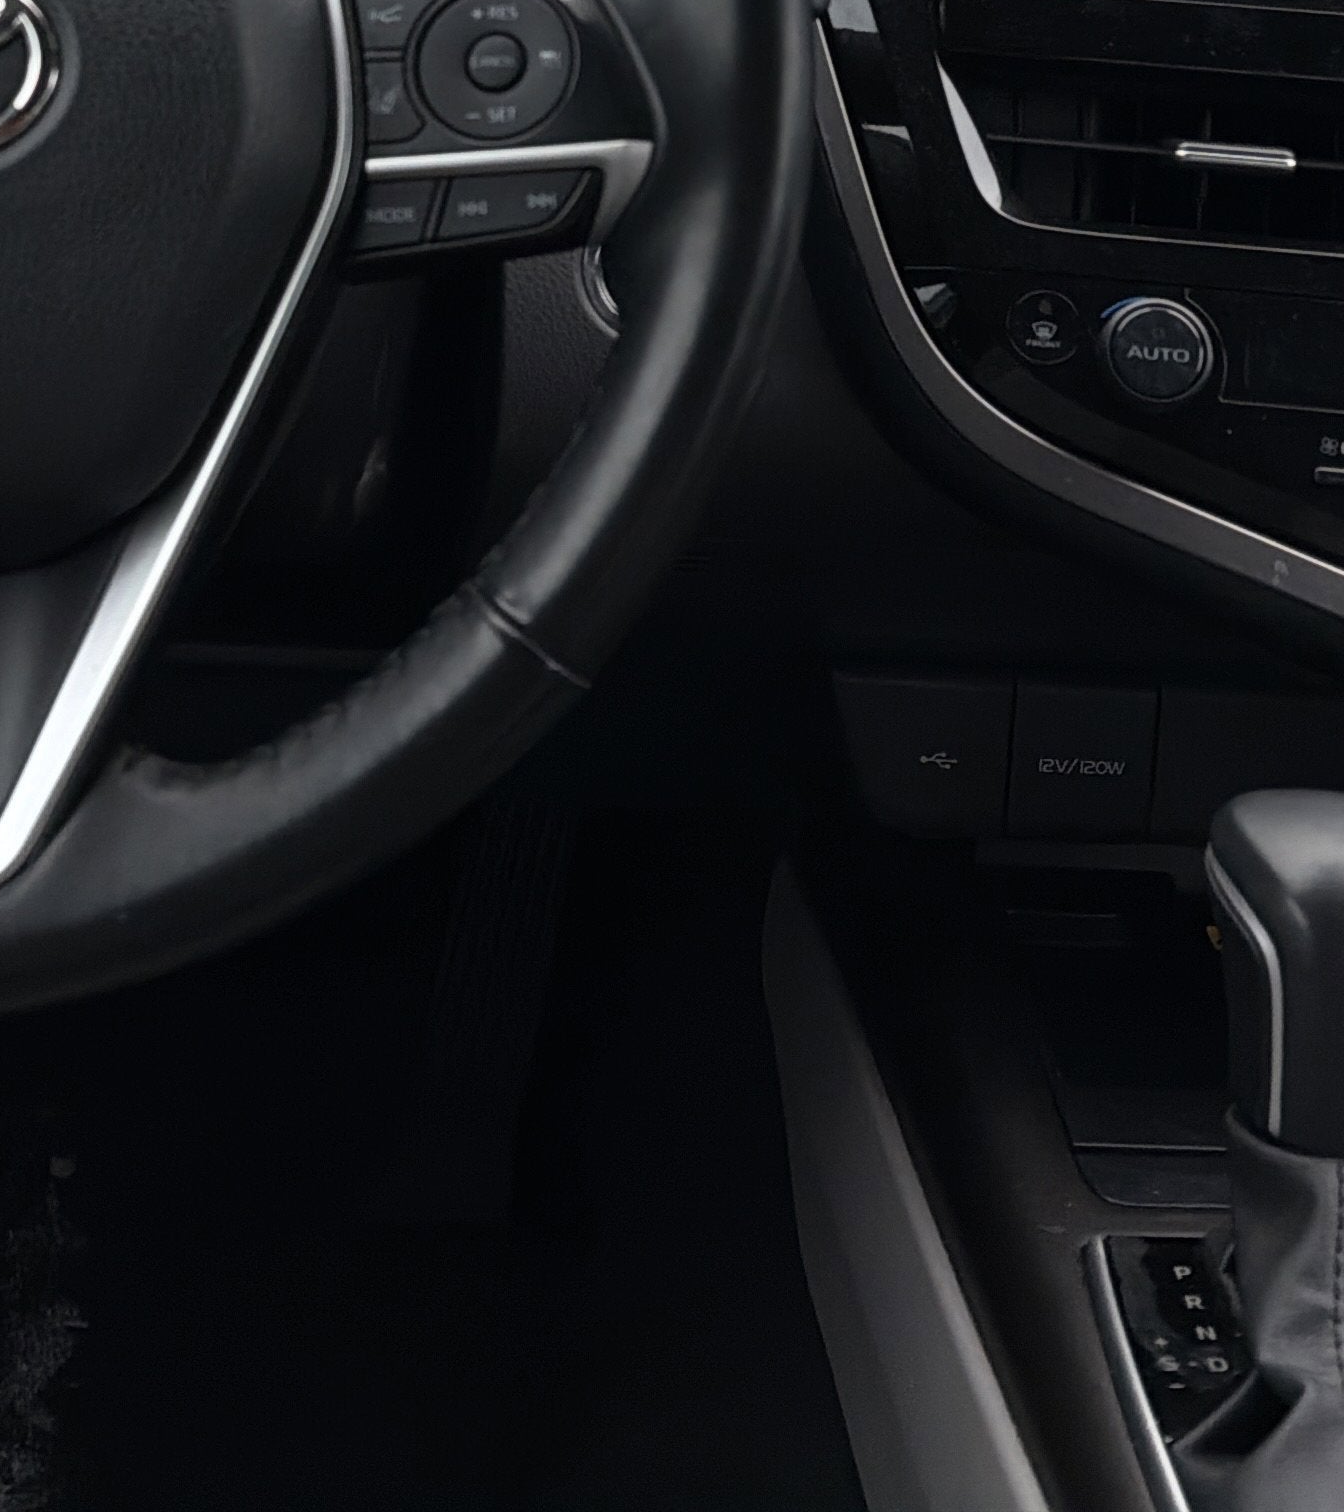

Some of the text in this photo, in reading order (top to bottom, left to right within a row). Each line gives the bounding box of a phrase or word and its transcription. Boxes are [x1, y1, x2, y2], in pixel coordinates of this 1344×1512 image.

[1126, 344, 1190, 364] AUTO
[1039, 758, 1125, 775] 12V/120W
[1173, 1265, 1191, 1279] P
[1184, 1295, 1205, 1309] R
[1195, 1326, 1217, 1340] N
